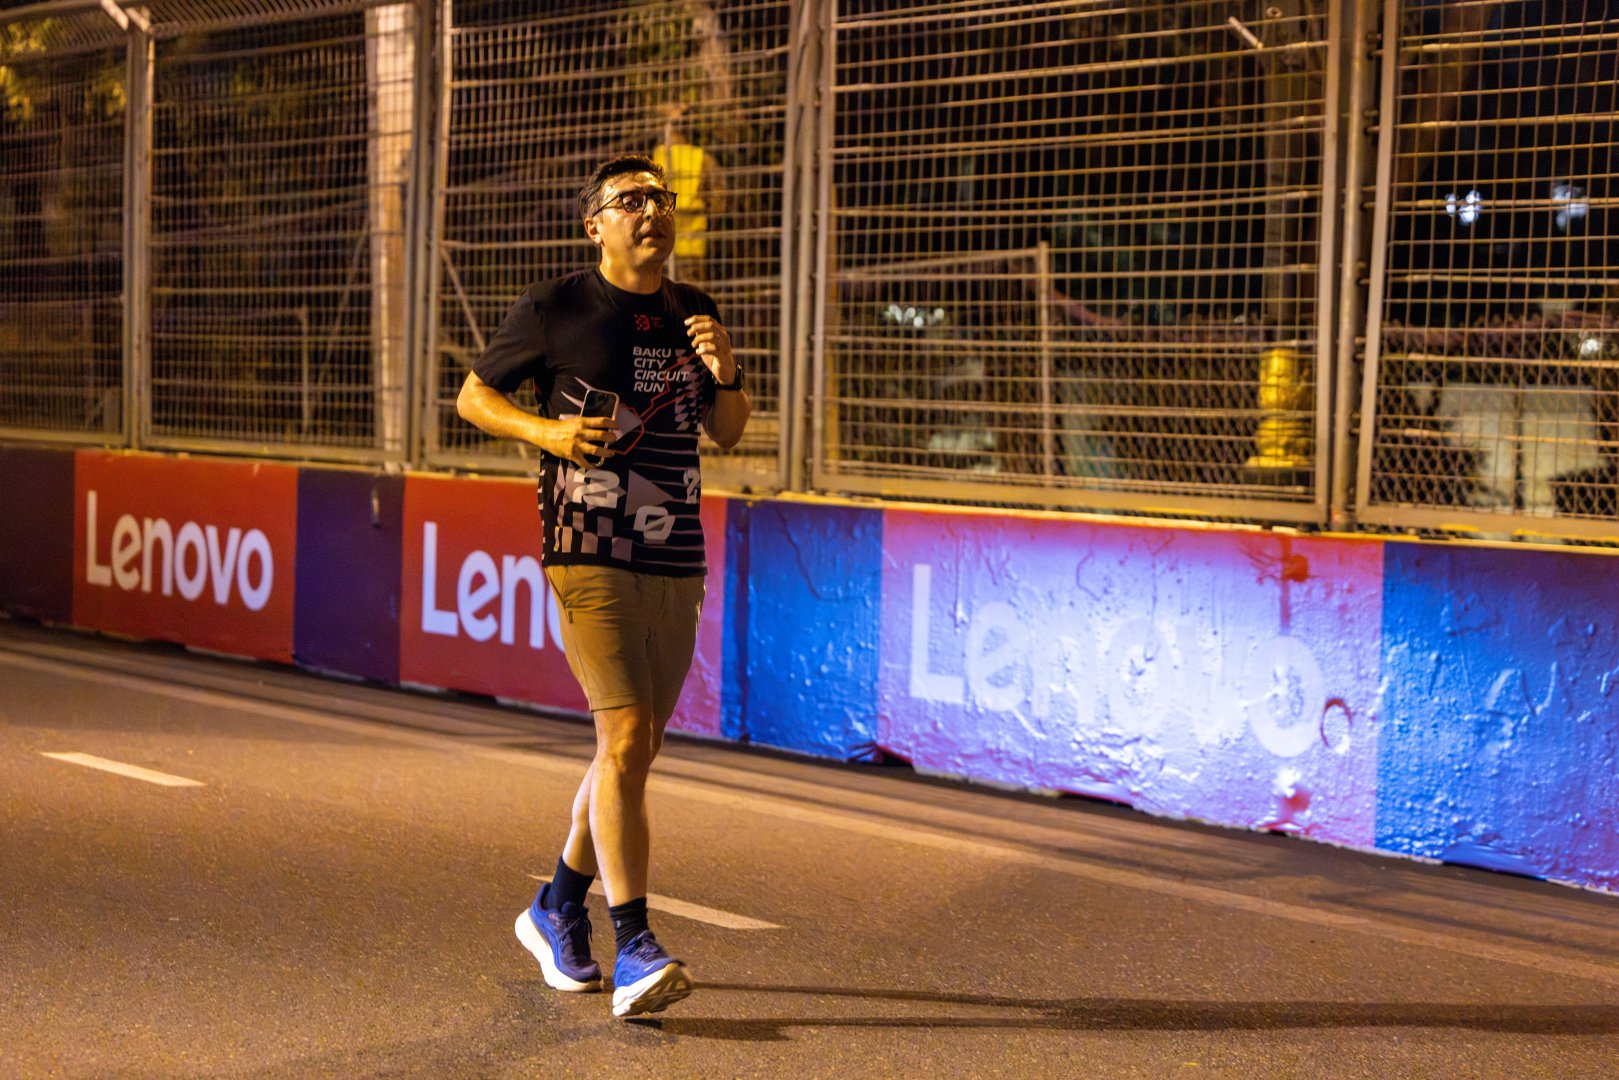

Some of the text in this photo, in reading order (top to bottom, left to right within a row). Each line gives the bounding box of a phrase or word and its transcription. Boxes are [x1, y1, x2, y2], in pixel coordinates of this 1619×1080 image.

[632, 346, 672, 358] BAKU
[634, 357, 667, 369] CITY
[634, 369, 689, 382] CIRCUIT
[634, 381, 666, 393] RUN
[86, 489, 274, 612] Lenovo
[422, 523, 566, 652] Len
[910, 563, 1324, 757] Lenovo
